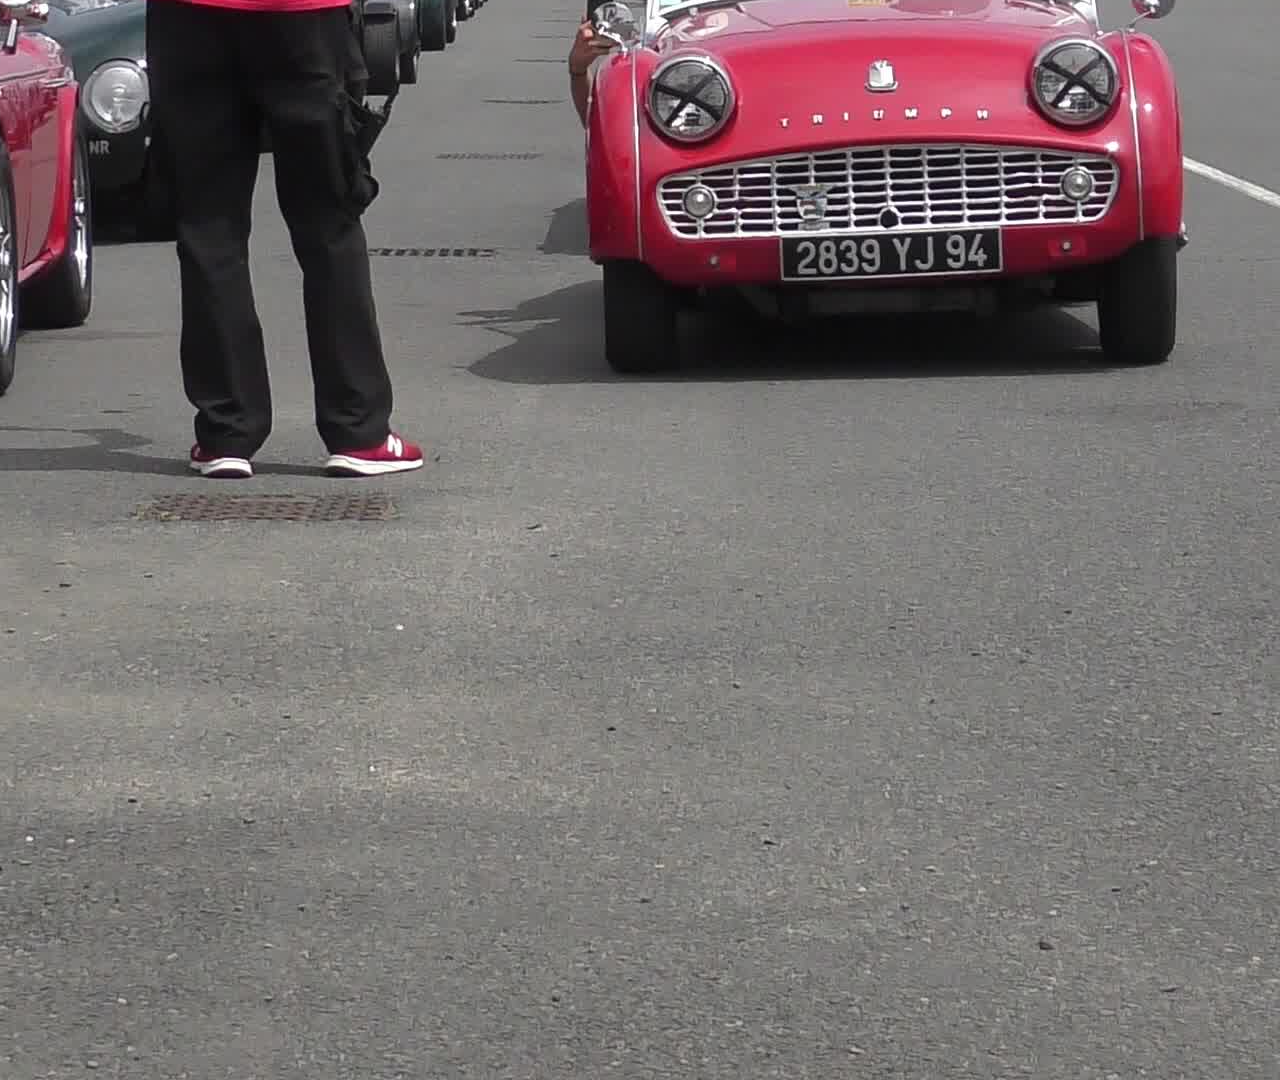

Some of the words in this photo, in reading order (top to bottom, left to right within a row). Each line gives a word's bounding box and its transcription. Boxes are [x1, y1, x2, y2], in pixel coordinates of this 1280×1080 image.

[780, 107, 989, 128] TRIUMPH
[796, 239, 881, 275] 2839
[892, 236, 935, 271] YJ
[946, 233, 988, 269] 94
